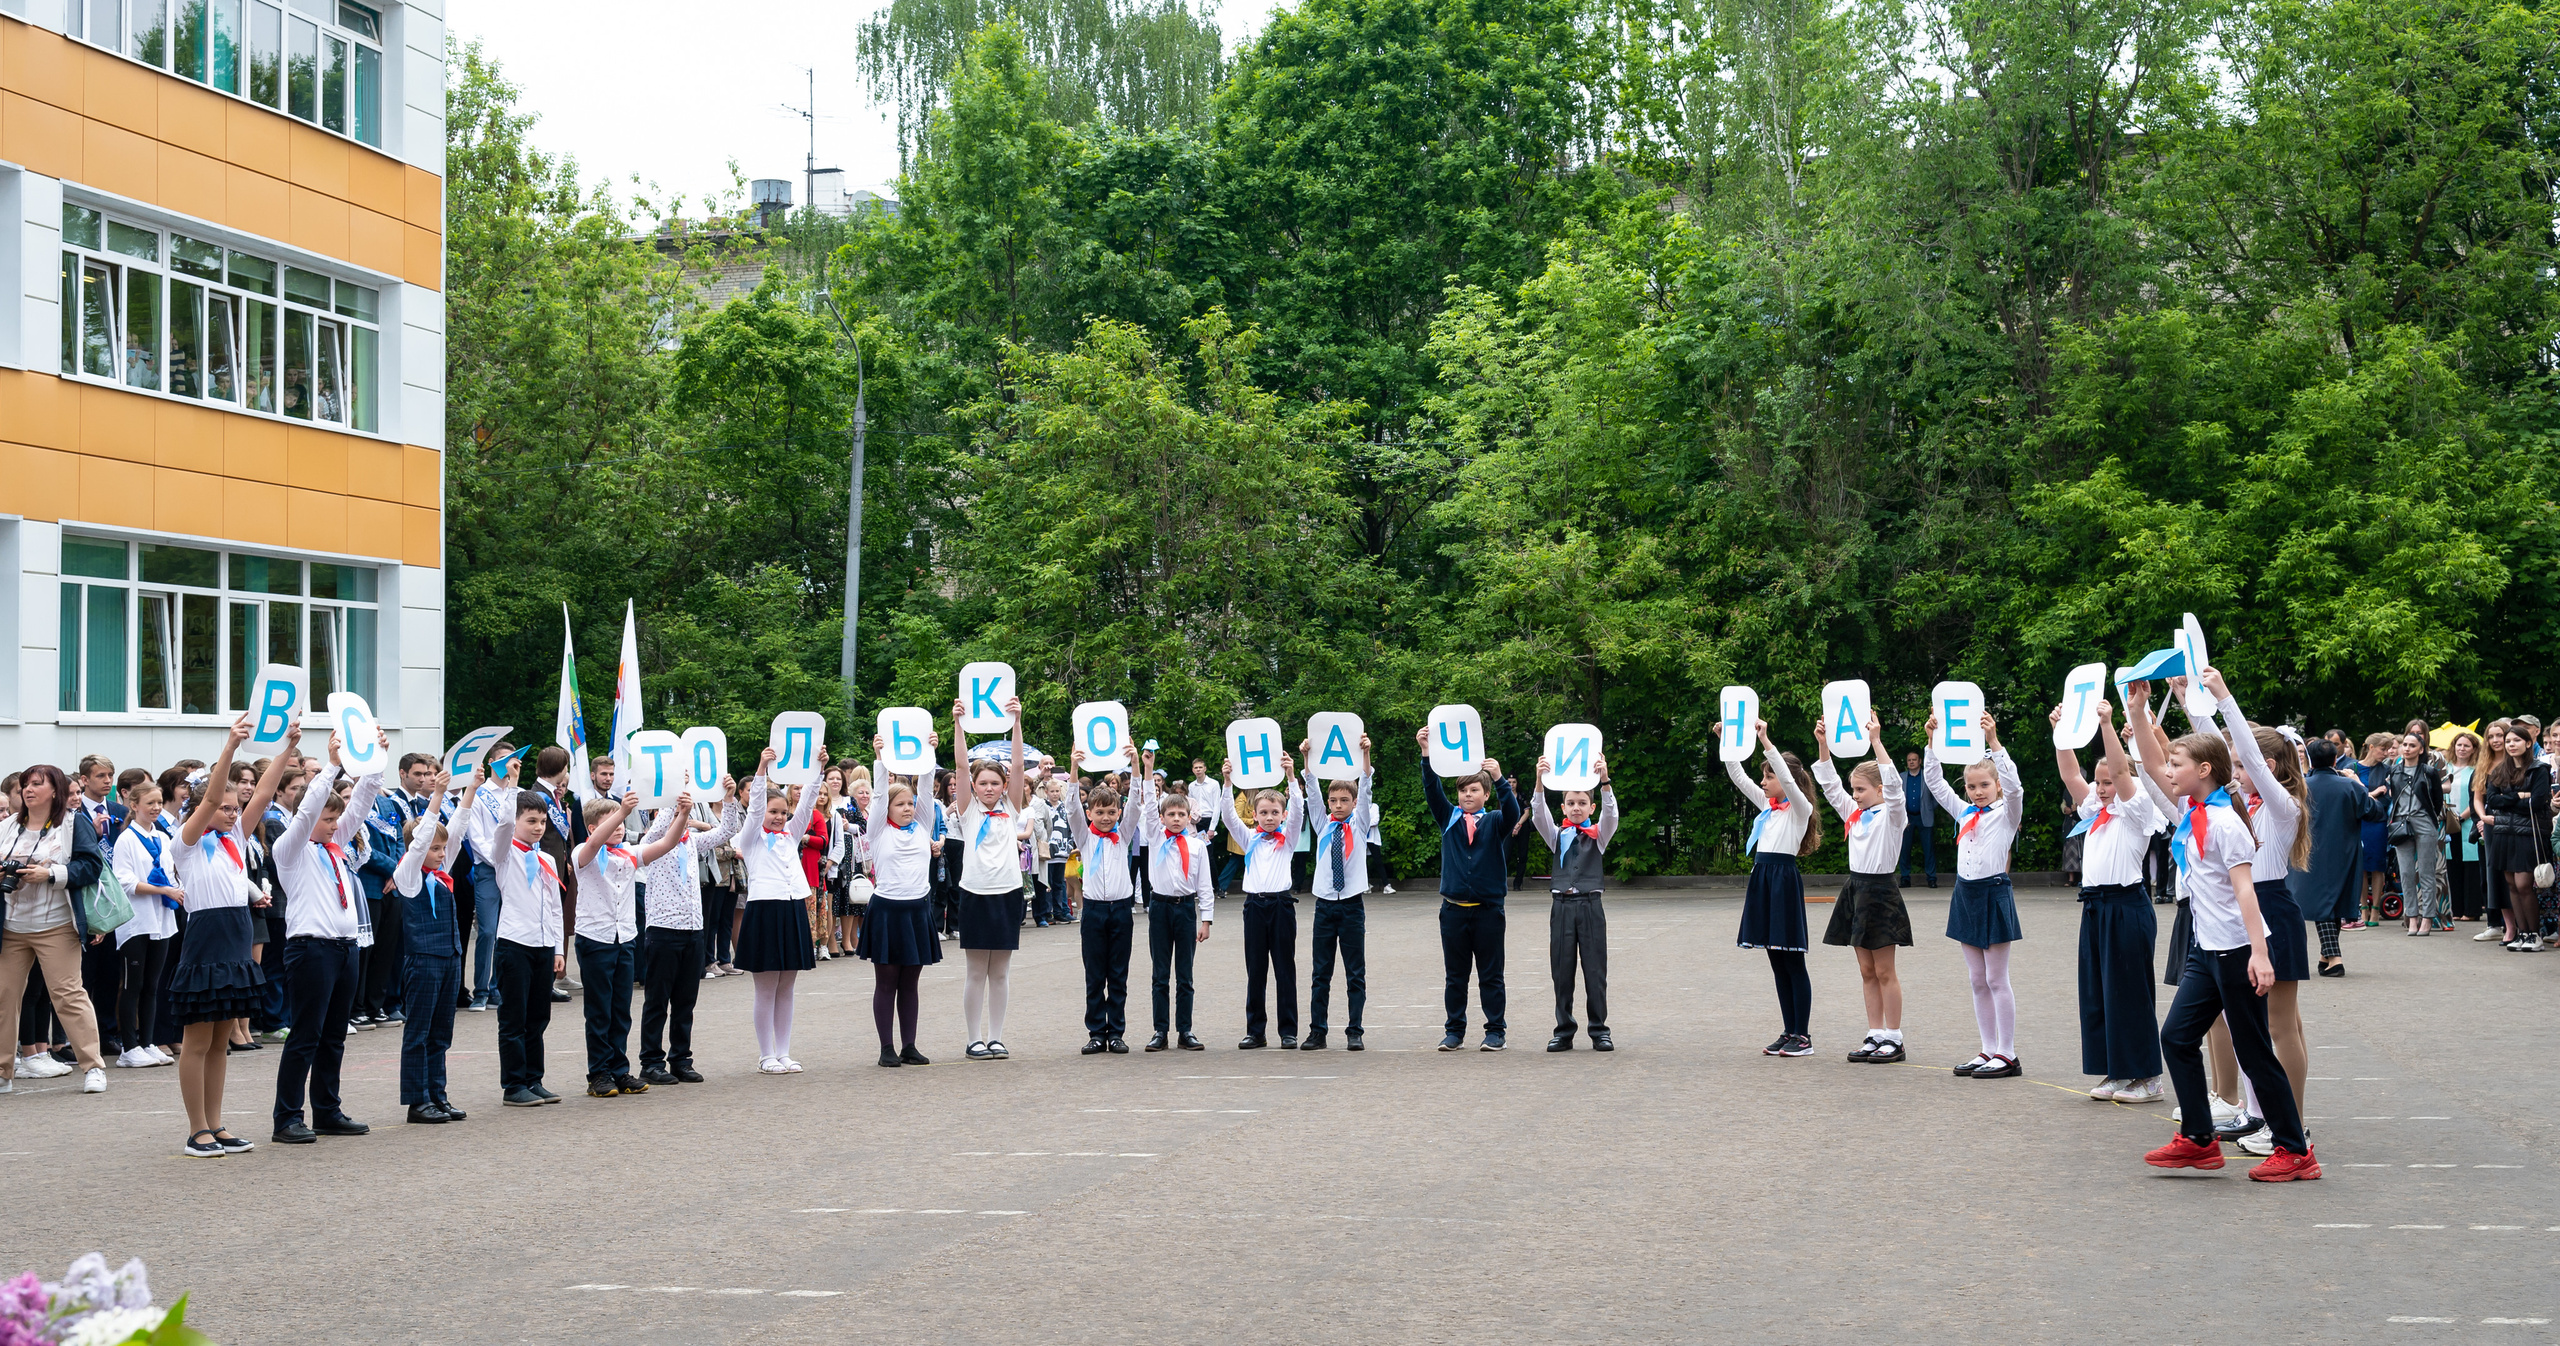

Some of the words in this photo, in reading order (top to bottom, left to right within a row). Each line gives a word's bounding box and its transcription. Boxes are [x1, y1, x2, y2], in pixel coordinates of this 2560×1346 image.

[253, 679, 297, 742] В
[972, 677, 1005, 719] К
[1835, 696, 1863, 743] А
[2074, 682, 2095, 732] Т
[343, 707, 374, 761] С
[892, 721, 922, 760] Ь
[1087, 716, 1116, 757] О
[1439, 721, 1470, 762] Ч
[1724, 701, 1745, 746] Н
[1944, 699, 1971, 747] Е
[694, 740, 718, 790] О
[777, 727, 812, 769] Л
[1238, 733, 1271, 775] Н
[1320, 725, 1354, 766] А
[1555, 737, 1589, 777] И
[641, 745, 672, 797] Т
